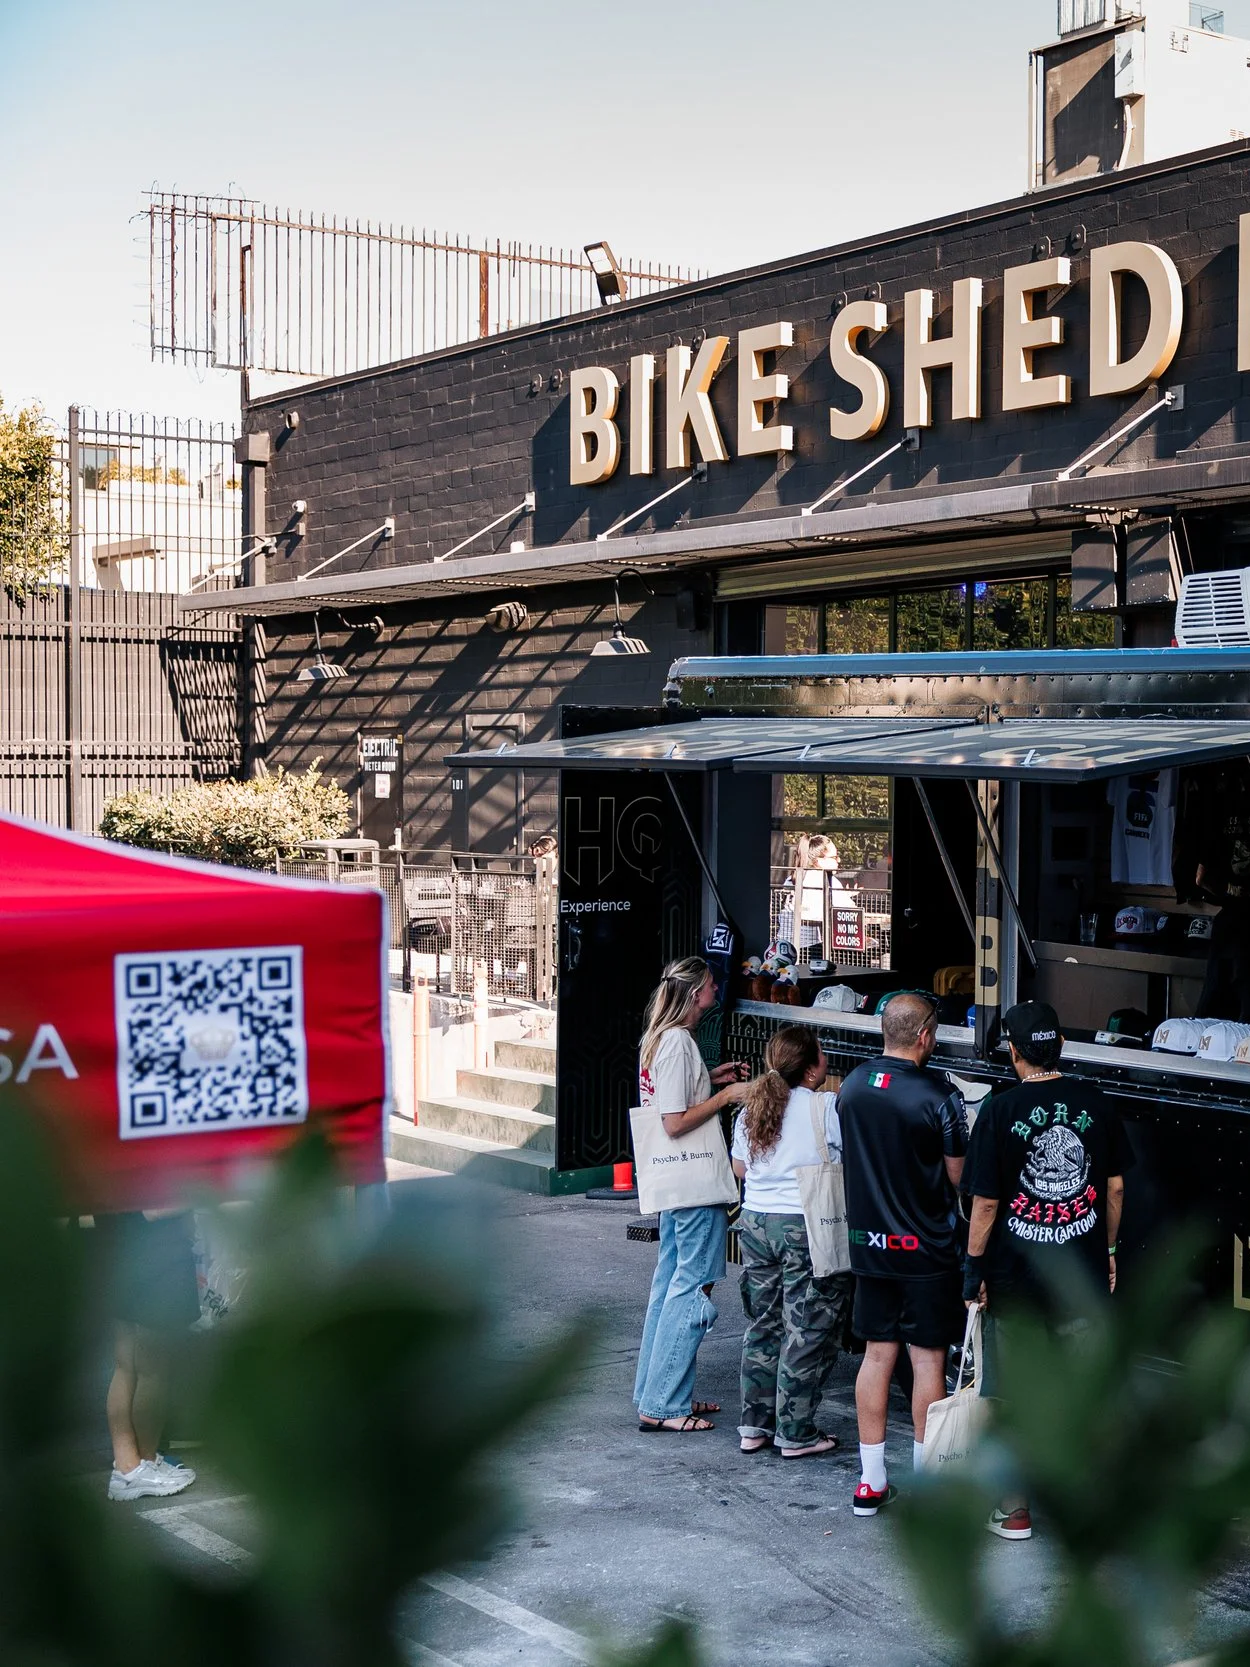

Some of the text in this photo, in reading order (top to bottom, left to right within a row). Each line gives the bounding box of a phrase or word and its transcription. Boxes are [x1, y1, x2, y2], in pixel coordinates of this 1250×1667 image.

[570, 321, 795, 485] BIKE
[829, 241, 1184, 441] SHED
[381, 761, 396, 772] ROOM
[563, 796, 663, 886] HQ
[560, 898, 632, 916] Experience
[836, 911, 859, 922] SORRY
[837, 923, 859, 935] NO MC
[835, 935, 861, 947] COLORS
[1011, 1102, 1094, 1141] BORN
[652, 1151, 714, 1165] Psycho Bunny
